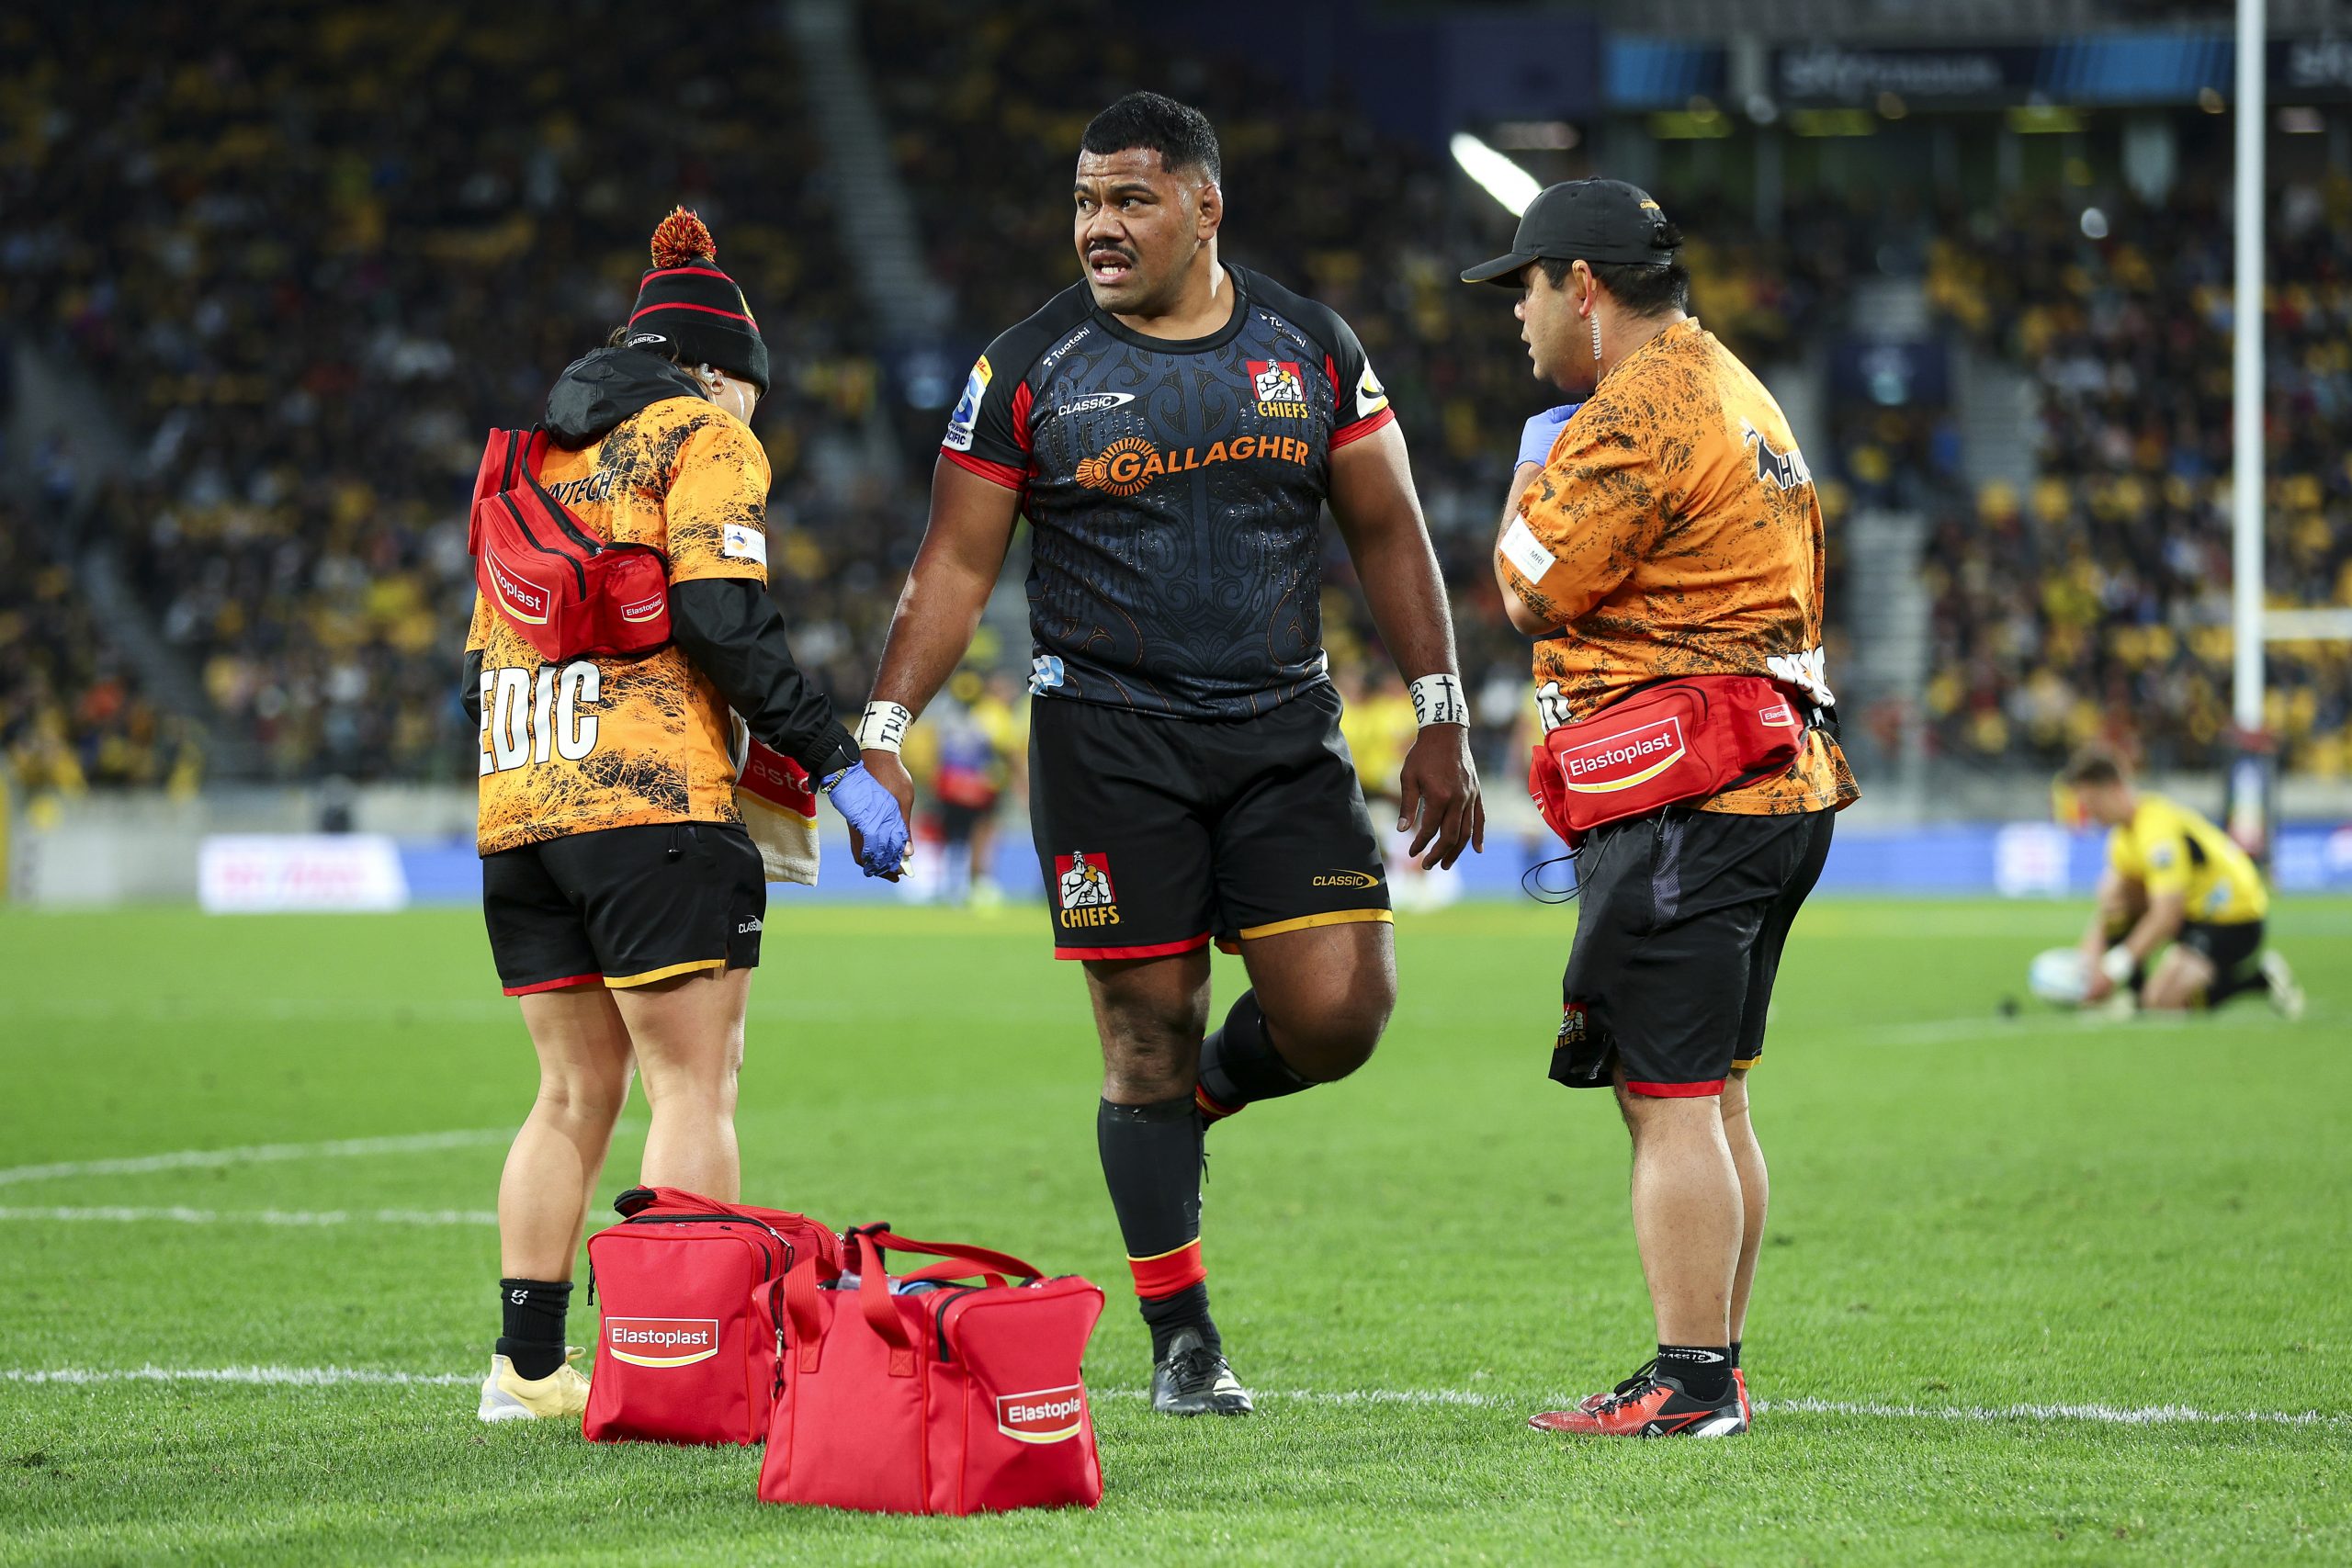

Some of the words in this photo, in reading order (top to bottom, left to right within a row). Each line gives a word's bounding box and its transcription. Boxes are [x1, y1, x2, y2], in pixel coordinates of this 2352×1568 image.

[1051, 327, 1091, 359] Tuatahi
[1058, 396, 1113, 416] CLASSIC
[1257, 401, 1309, 419] CHIEFS
[1109, 435, 1309, 483] GALLAGHER
[1529, 550, 1544, 566] MRI
[627, 598, 663, 616] Elastoplast
[1411, 681, 1426, 724] GOD
[1569, 732, 1673, 777] Elastoplast
[1313, 875, 1364, 886] CLASSIC
[1060, 905, 1120, 929] CHIEFS
[612, 1327, 708, 1348] Elastoplast
